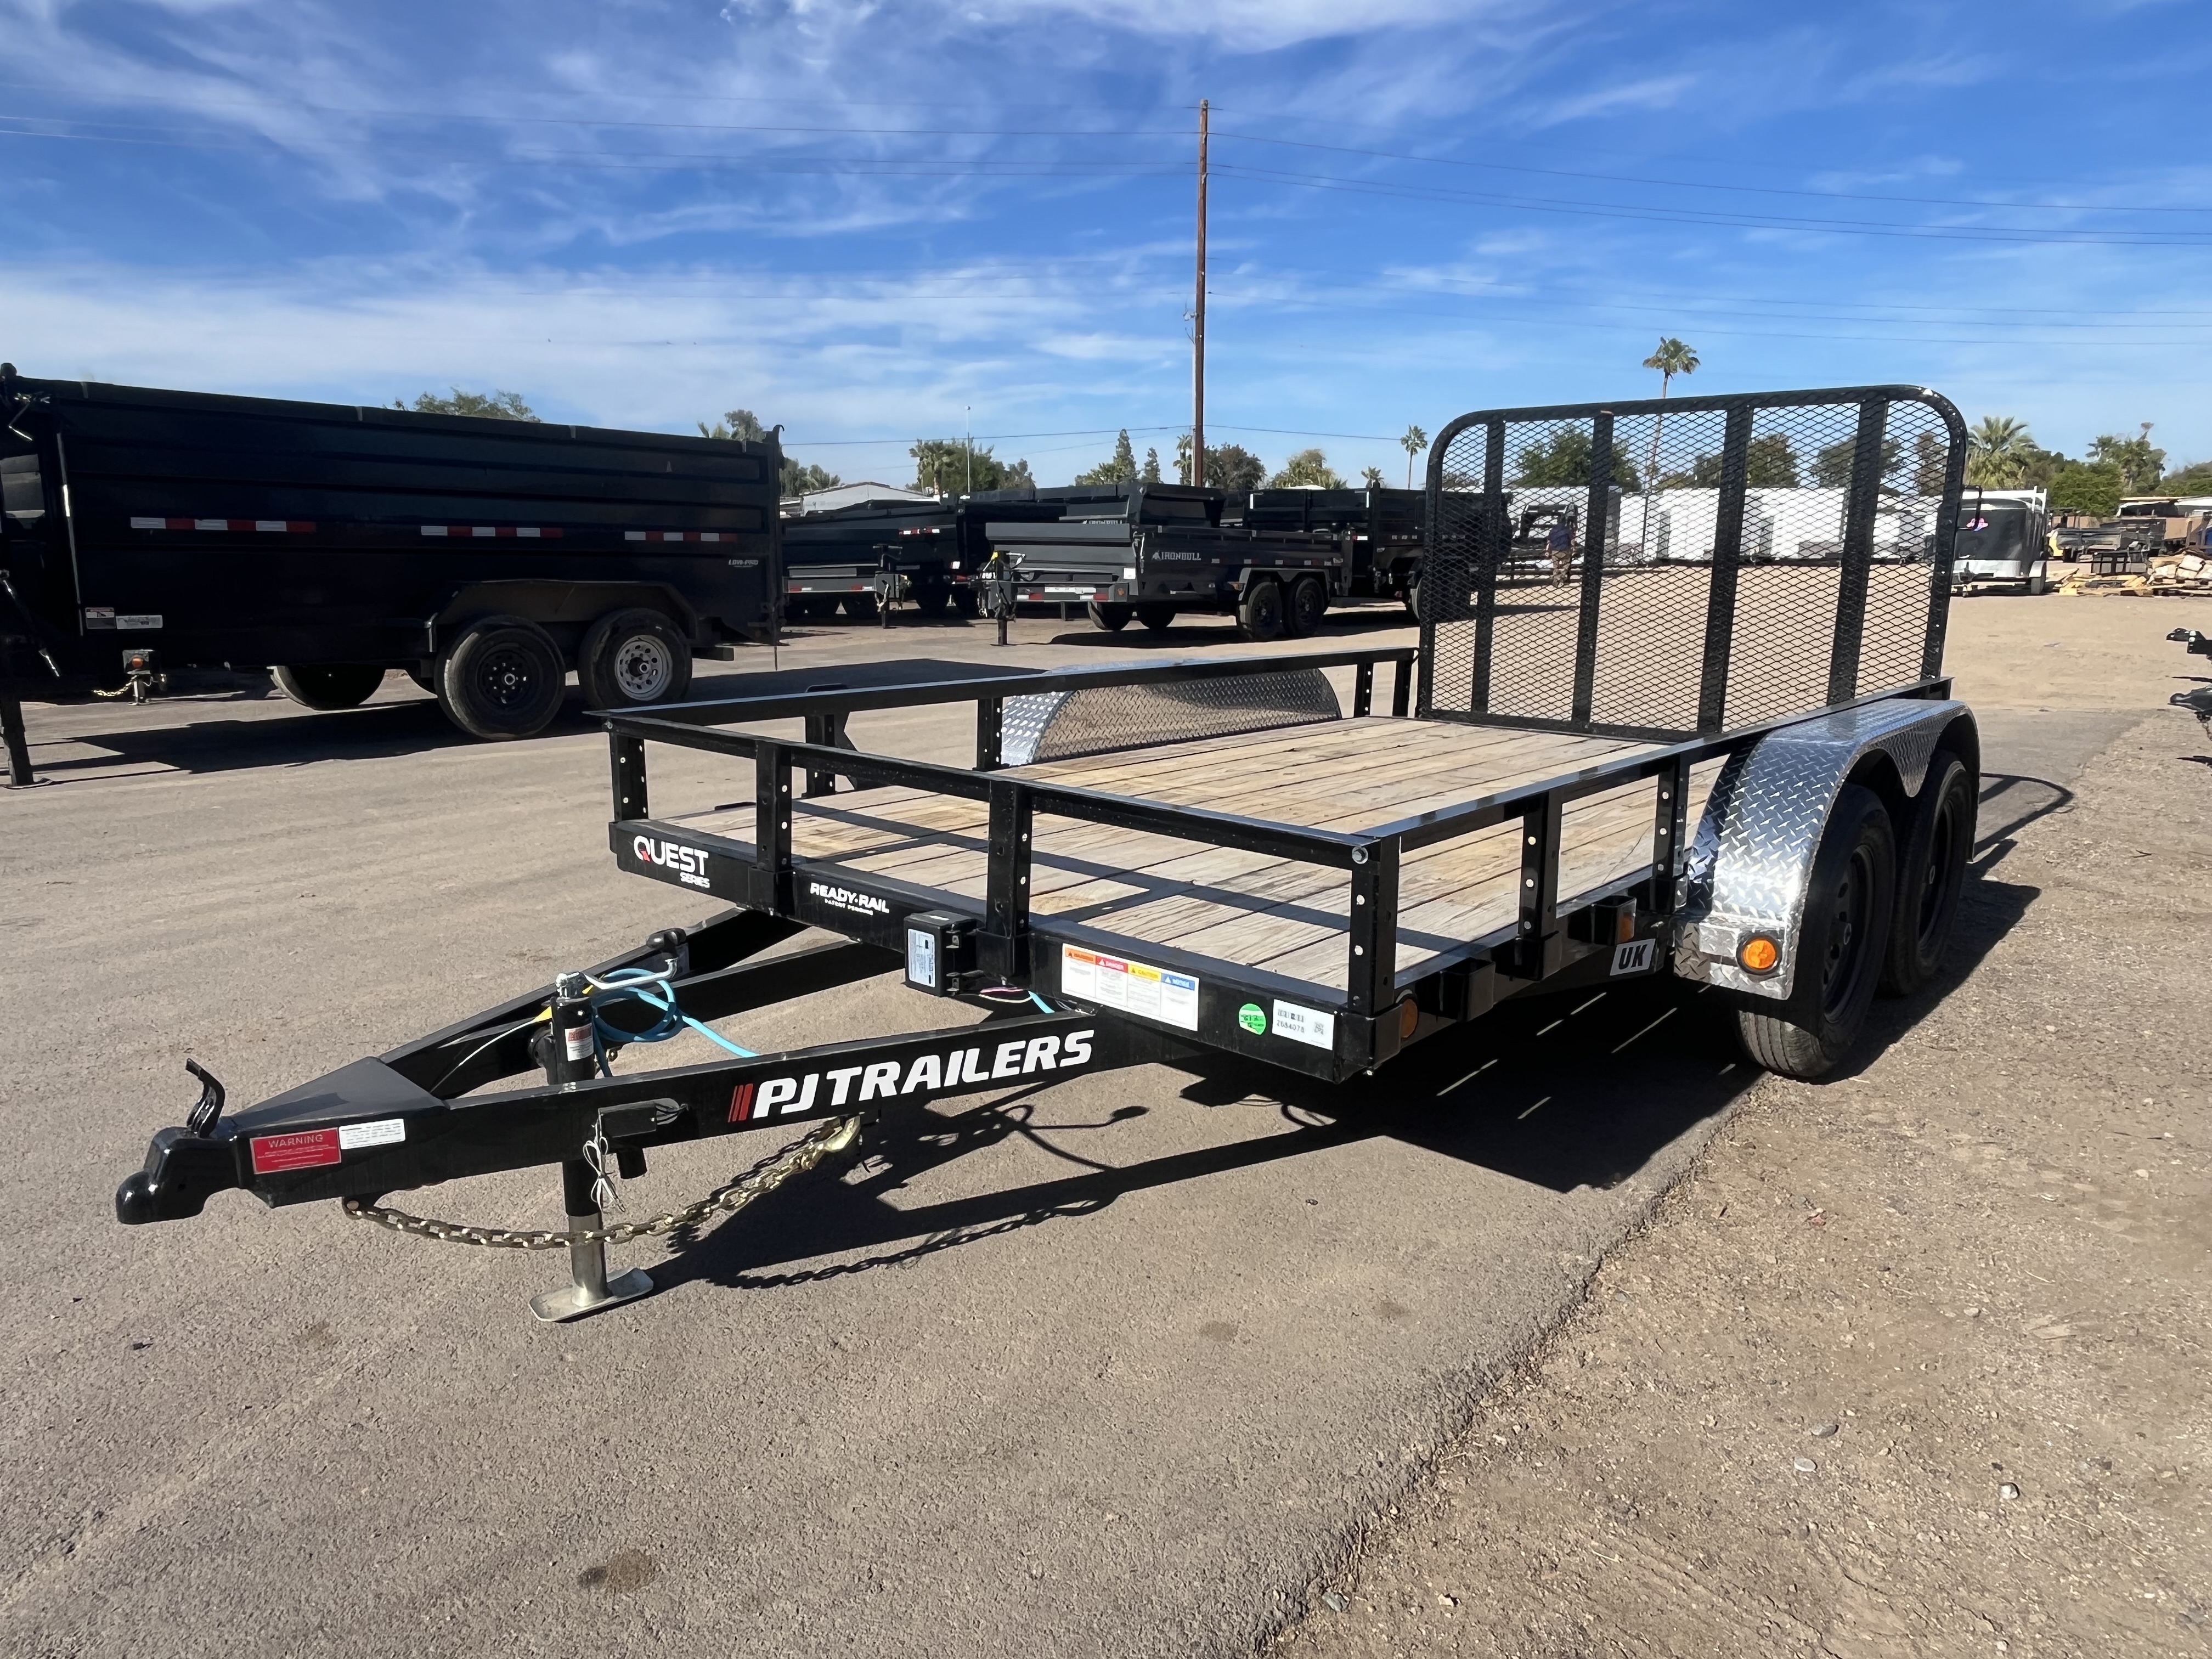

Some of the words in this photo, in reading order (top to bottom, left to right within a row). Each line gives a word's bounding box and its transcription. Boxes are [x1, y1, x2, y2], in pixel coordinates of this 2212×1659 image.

[634, 835, 709, 876] QUEST
[680, 872, 710, 888] SERIES
[1618, 944, 1648, 970] UK
[752, 1073, 820, 1119] PJ
[826, 1029, 1095, 1106] TRAILERS
[268, 1134, 324, 1148] WARNING
